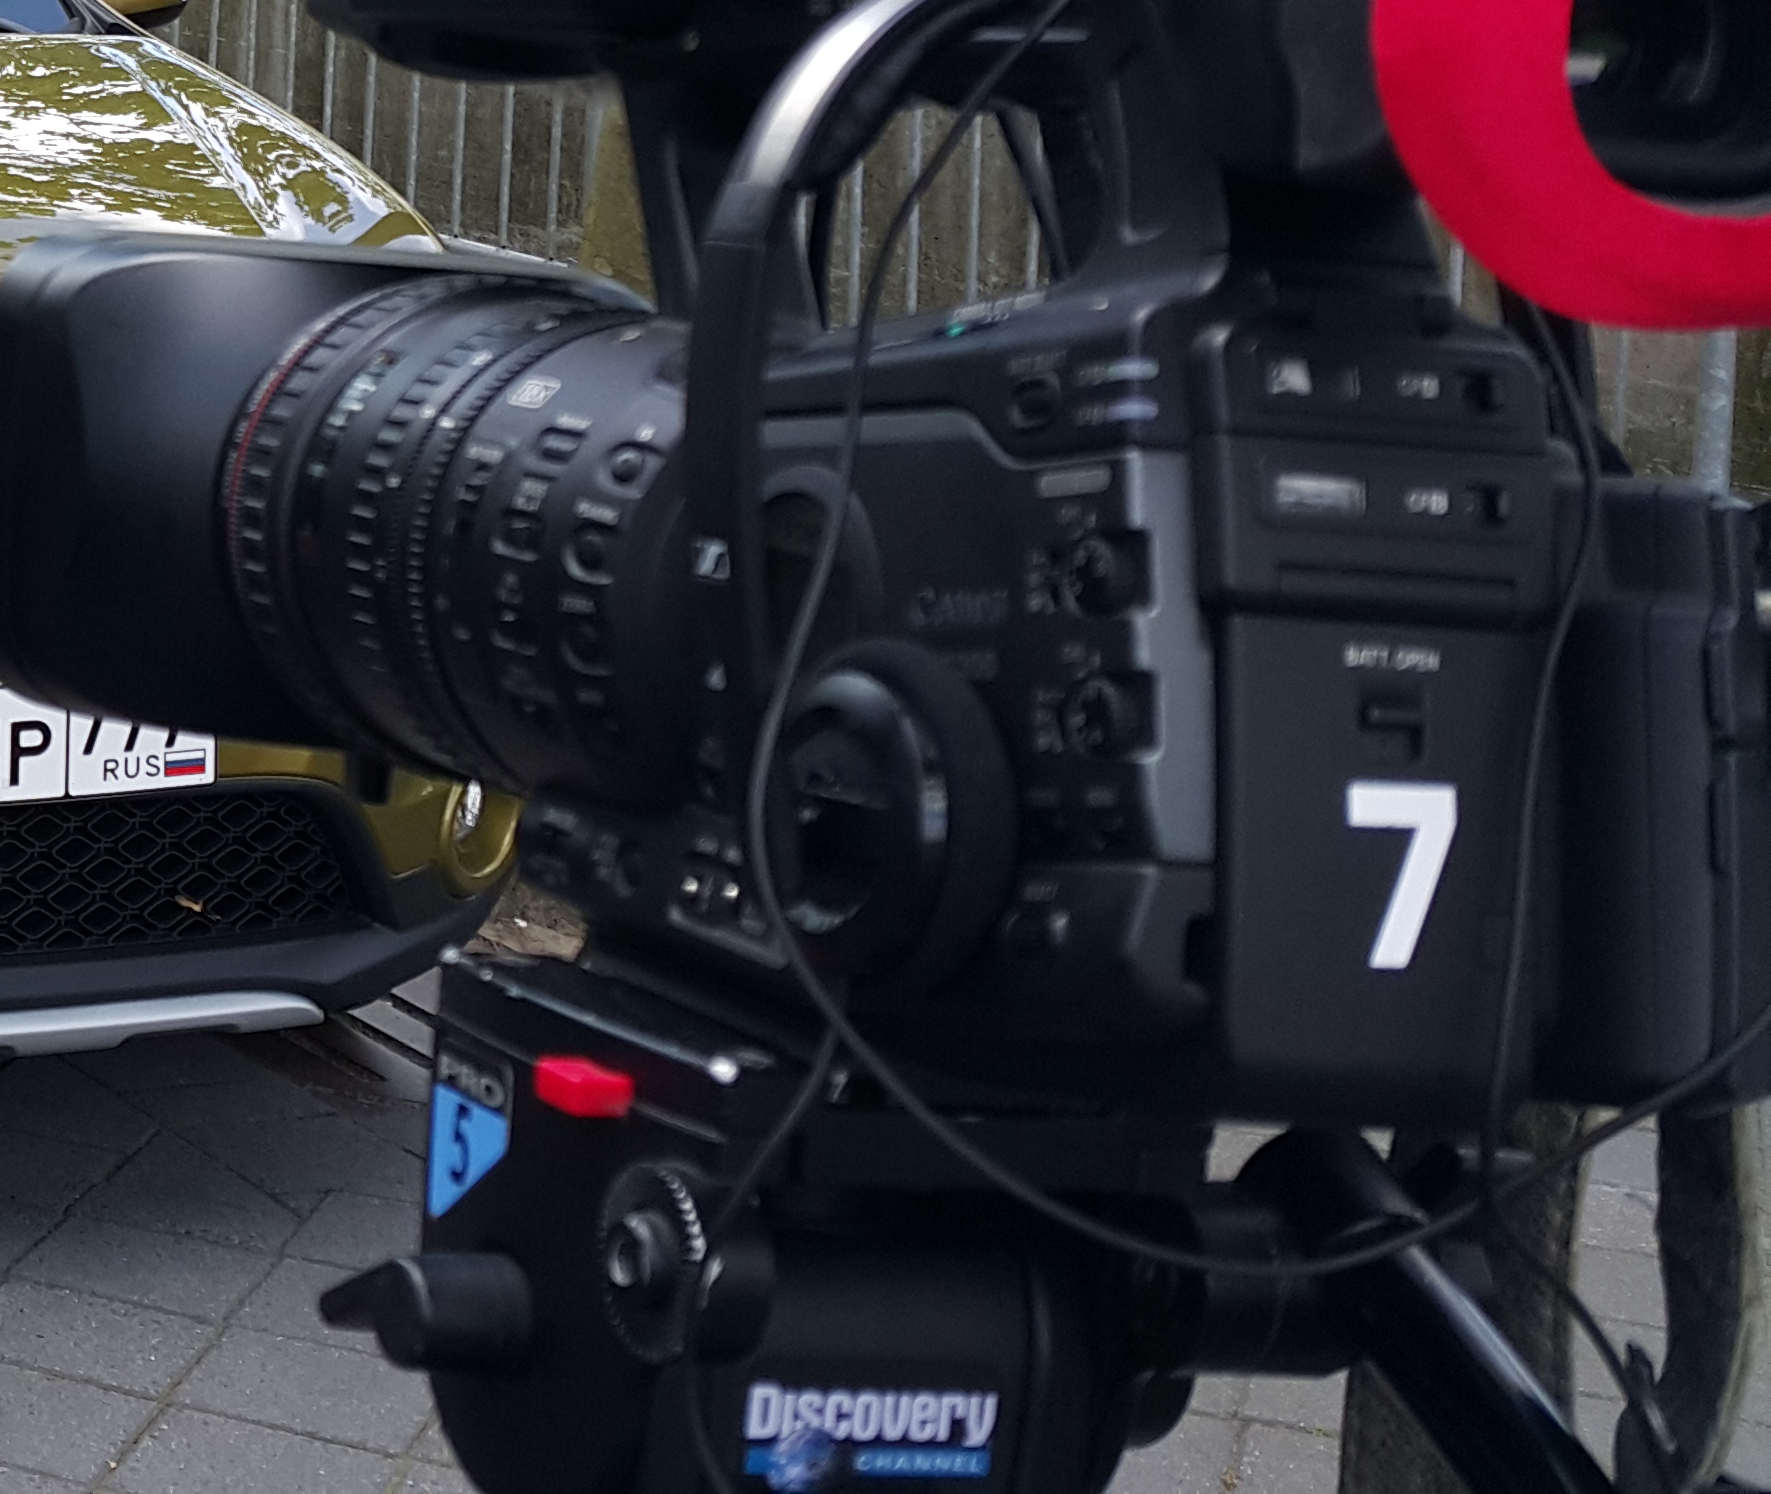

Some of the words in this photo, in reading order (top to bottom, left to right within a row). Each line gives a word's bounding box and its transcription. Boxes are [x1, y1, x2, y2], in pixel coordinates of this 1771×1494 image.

[102, 755, 161, 782] RUS
[1346, 781, 1458, 970] 7
[436, 1054, 506, 1110] PRO
[449, 1101, 474, 1187] 5
[745, 1382, 1000, 1449] Discovery
[856, 1452, 988, 1473] CHANNEL
